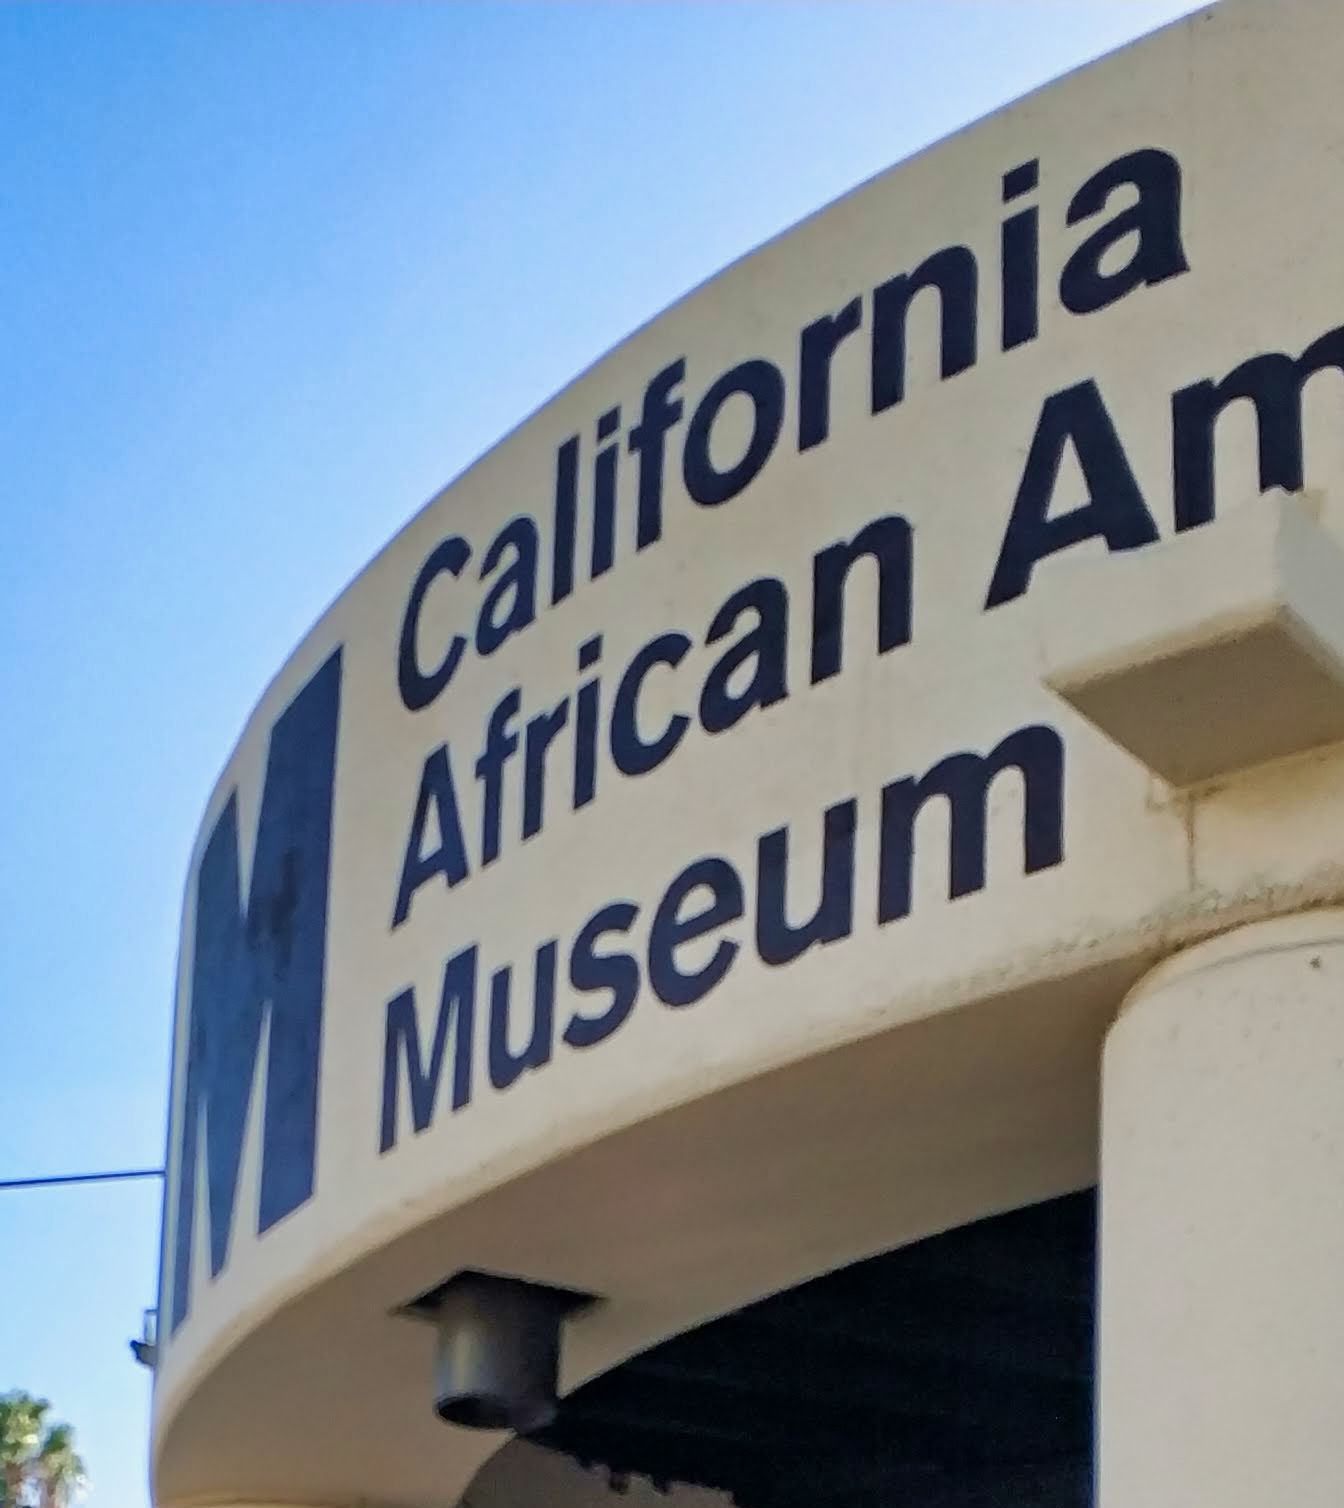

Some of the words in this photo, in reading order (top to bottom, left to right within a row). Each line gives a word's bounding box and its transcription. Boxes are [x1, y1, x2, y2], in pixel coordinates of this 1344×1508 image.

[397, 148, 1191, 713] California
[379, 725, 1065, 1154] Museum
[391, 515, 914, 930] African
[170, 643, 345, 1338] M
